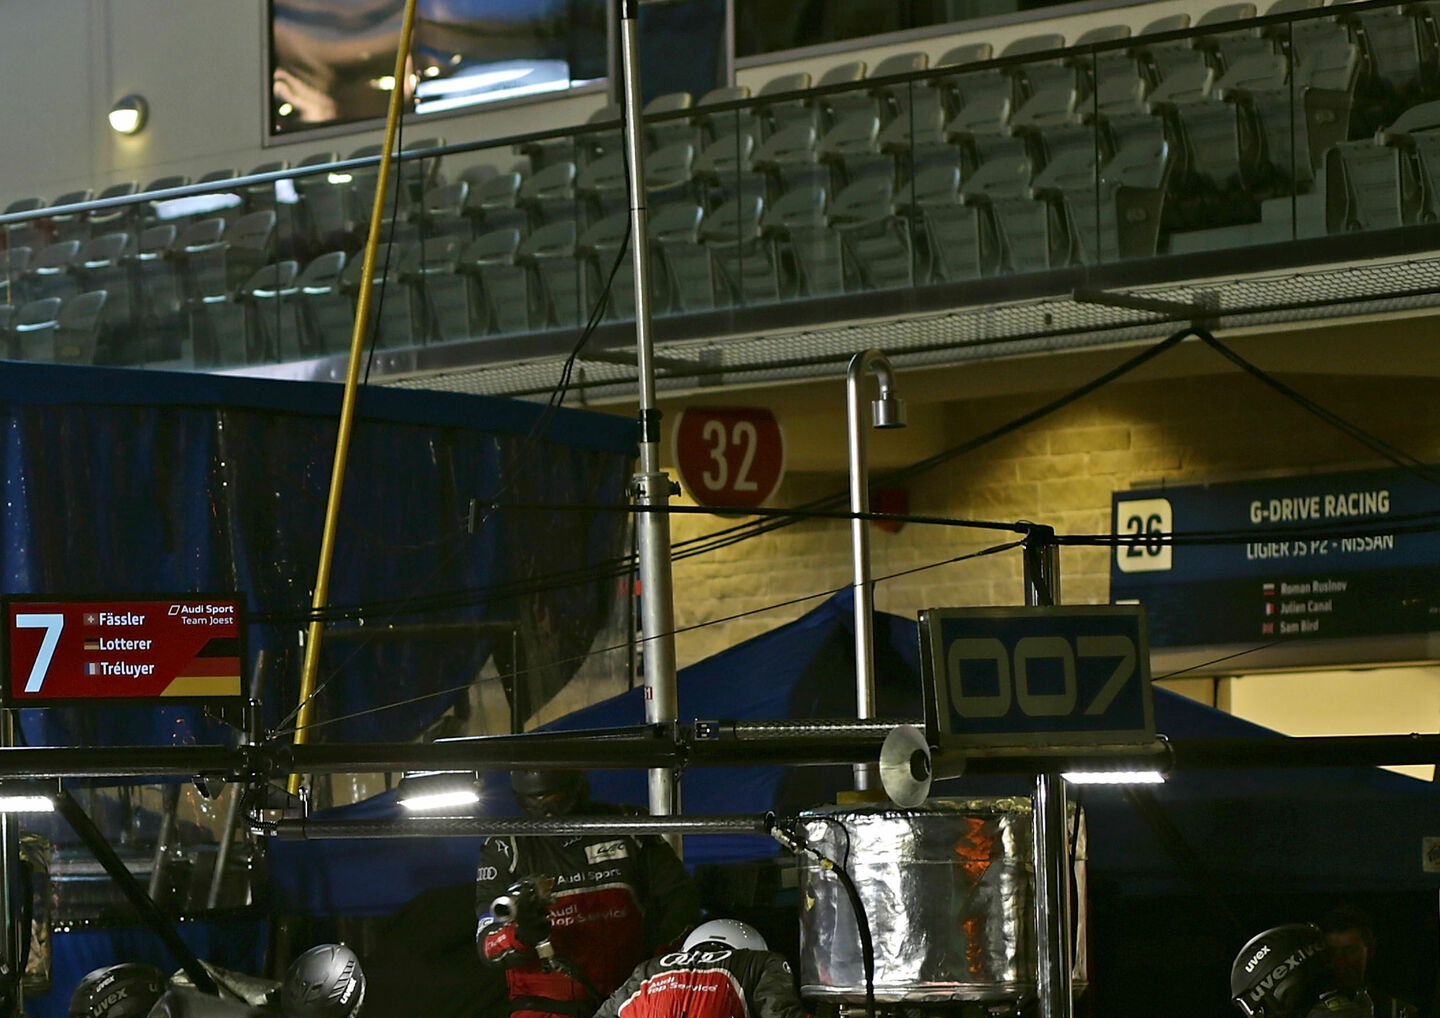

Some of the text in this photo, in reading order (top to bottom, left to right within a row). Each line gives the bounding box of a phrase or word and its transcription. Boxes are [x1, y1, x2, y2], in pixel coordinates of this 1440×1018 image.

[701, 420, 758, 493] 32
[1250, 490, 1389, 523] G-DRIVE RACING
[1126, 514, 1163, 557] 26
[99, 612, 145, 626] Fässler
[181, 604, 233, 616] Audi Sport
[181, 616, 233, 626] Team Joest
[15, 613, 64, 693] 7
[99, 638, 152, 650] Lotterer
[101, 661, 154, 678] Tréluyer
[948, 633, 1140, 720] 007
[557, 867, 622, 885] Audi Sport
[1245, 945, 1271, 973] uvex
[96, 976, 116, 993] uvex
[650, 976, 675, 988] Audi
[93, 986, 128, 1016] uvex
